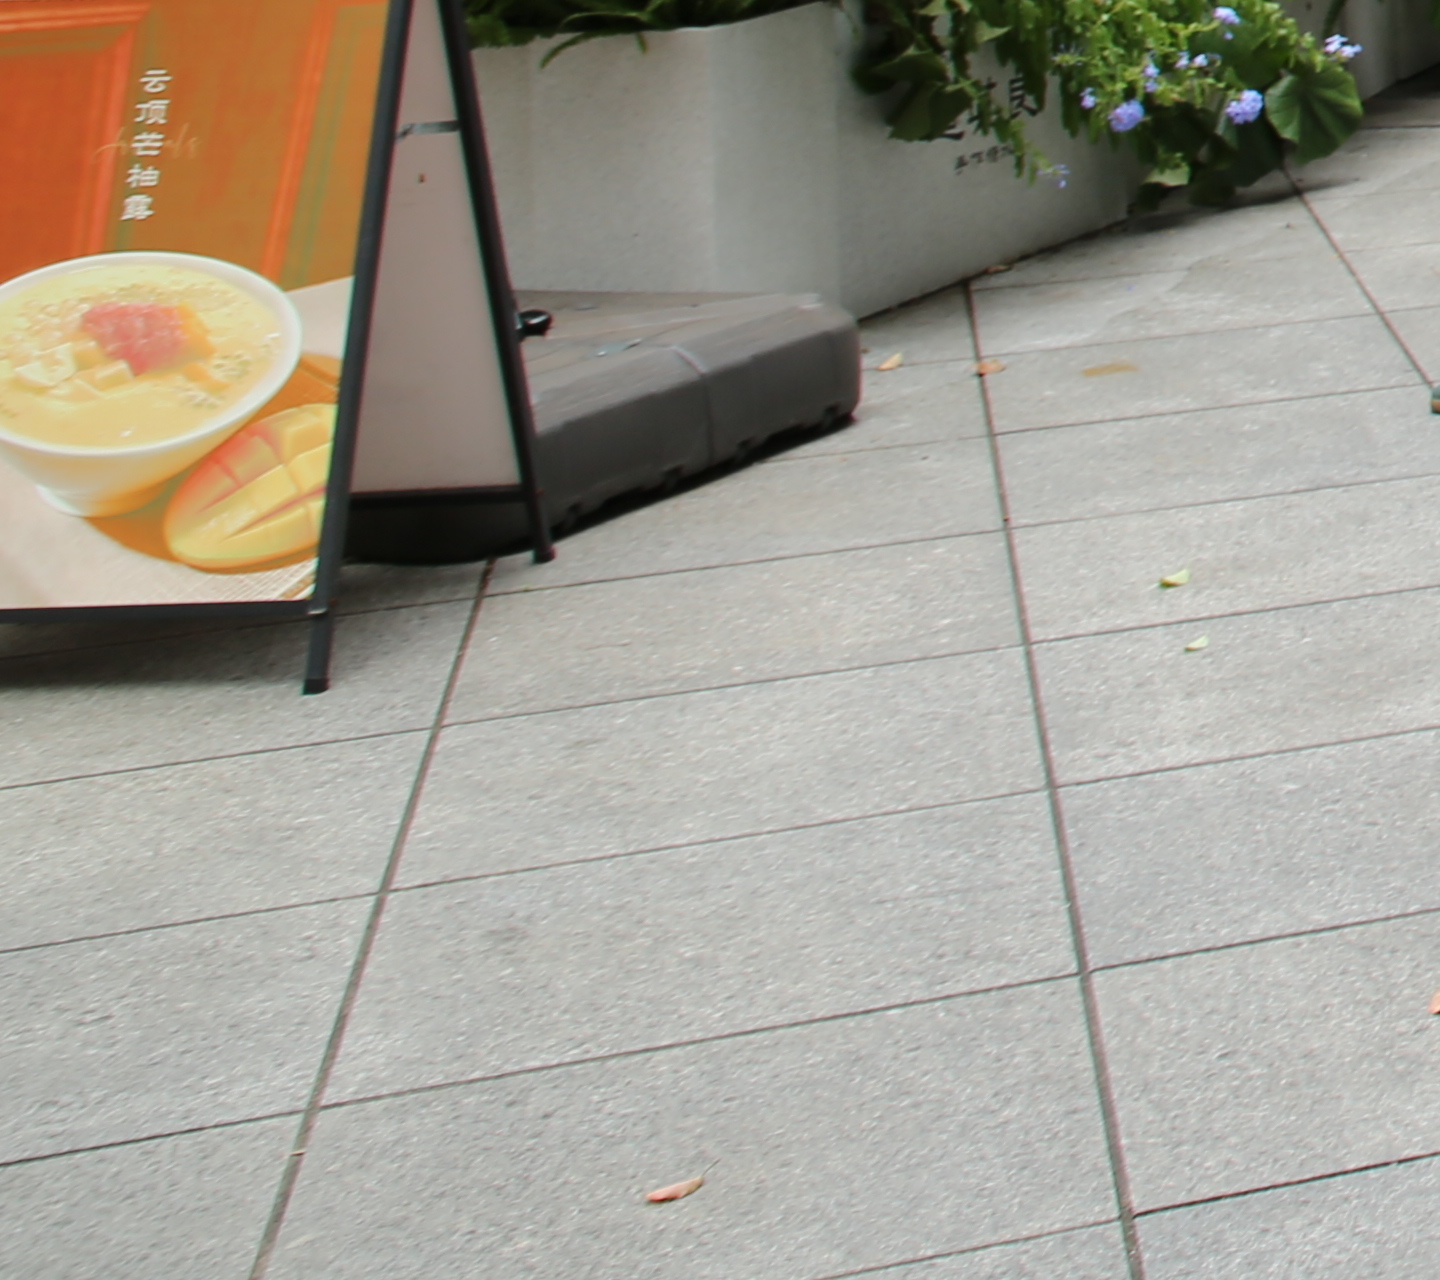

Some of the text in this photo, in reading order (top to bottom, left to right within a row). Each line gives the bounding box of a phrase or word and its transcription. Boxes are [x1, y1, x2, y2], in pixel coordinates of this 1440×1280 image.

[120, 69, 172, 220] 云顶芒柚露
